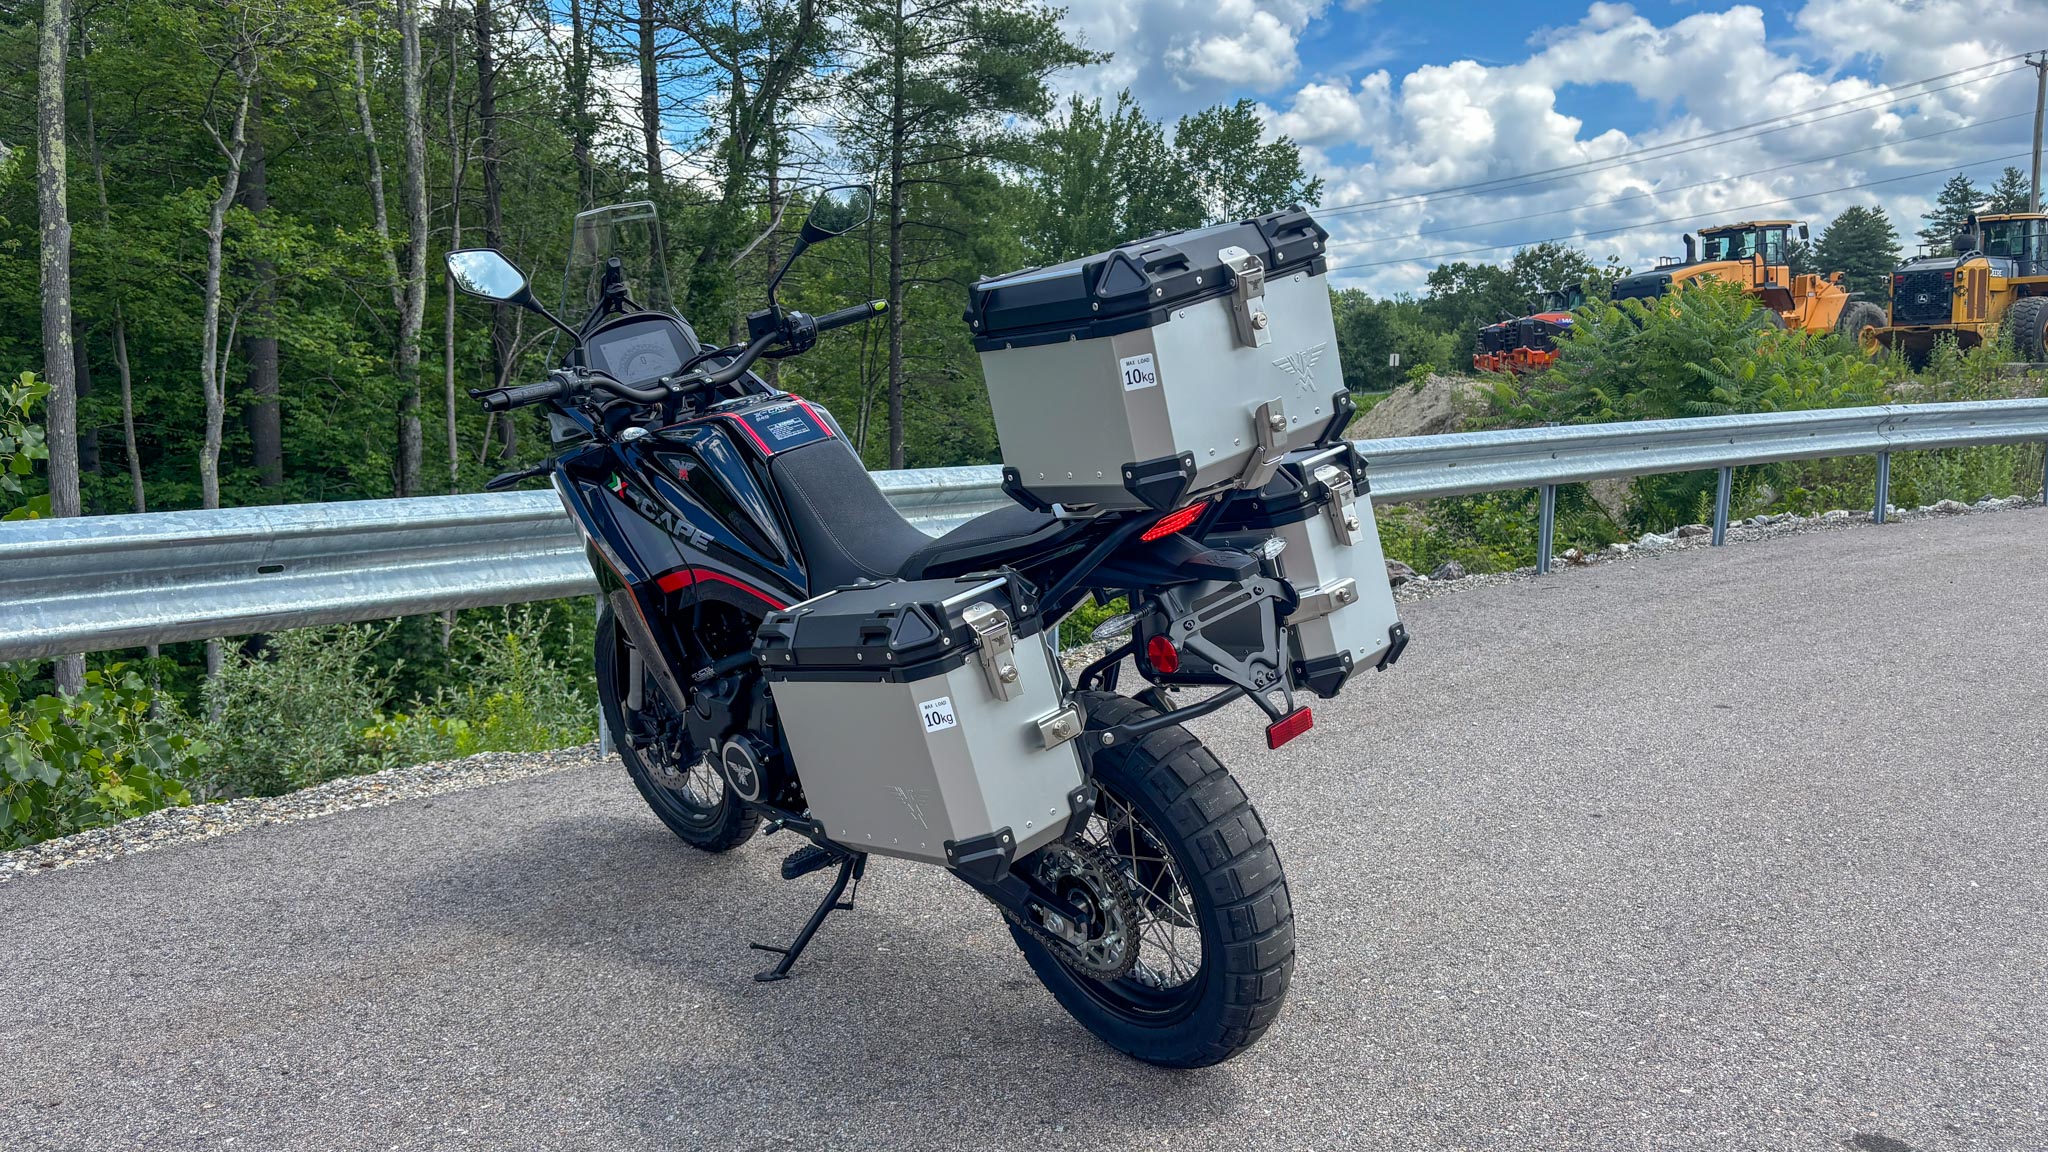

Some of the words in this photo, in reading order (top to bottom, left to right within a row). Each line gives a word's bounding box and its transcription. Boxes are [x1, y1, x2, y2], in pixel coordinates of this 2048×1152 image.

[1137, 357, 1151, 365] LOAD
[1125, 368, 1155, 386] 10kg
[934, 700, 947, 708] LOAD
[924, 711, 954, 727] 10kg
